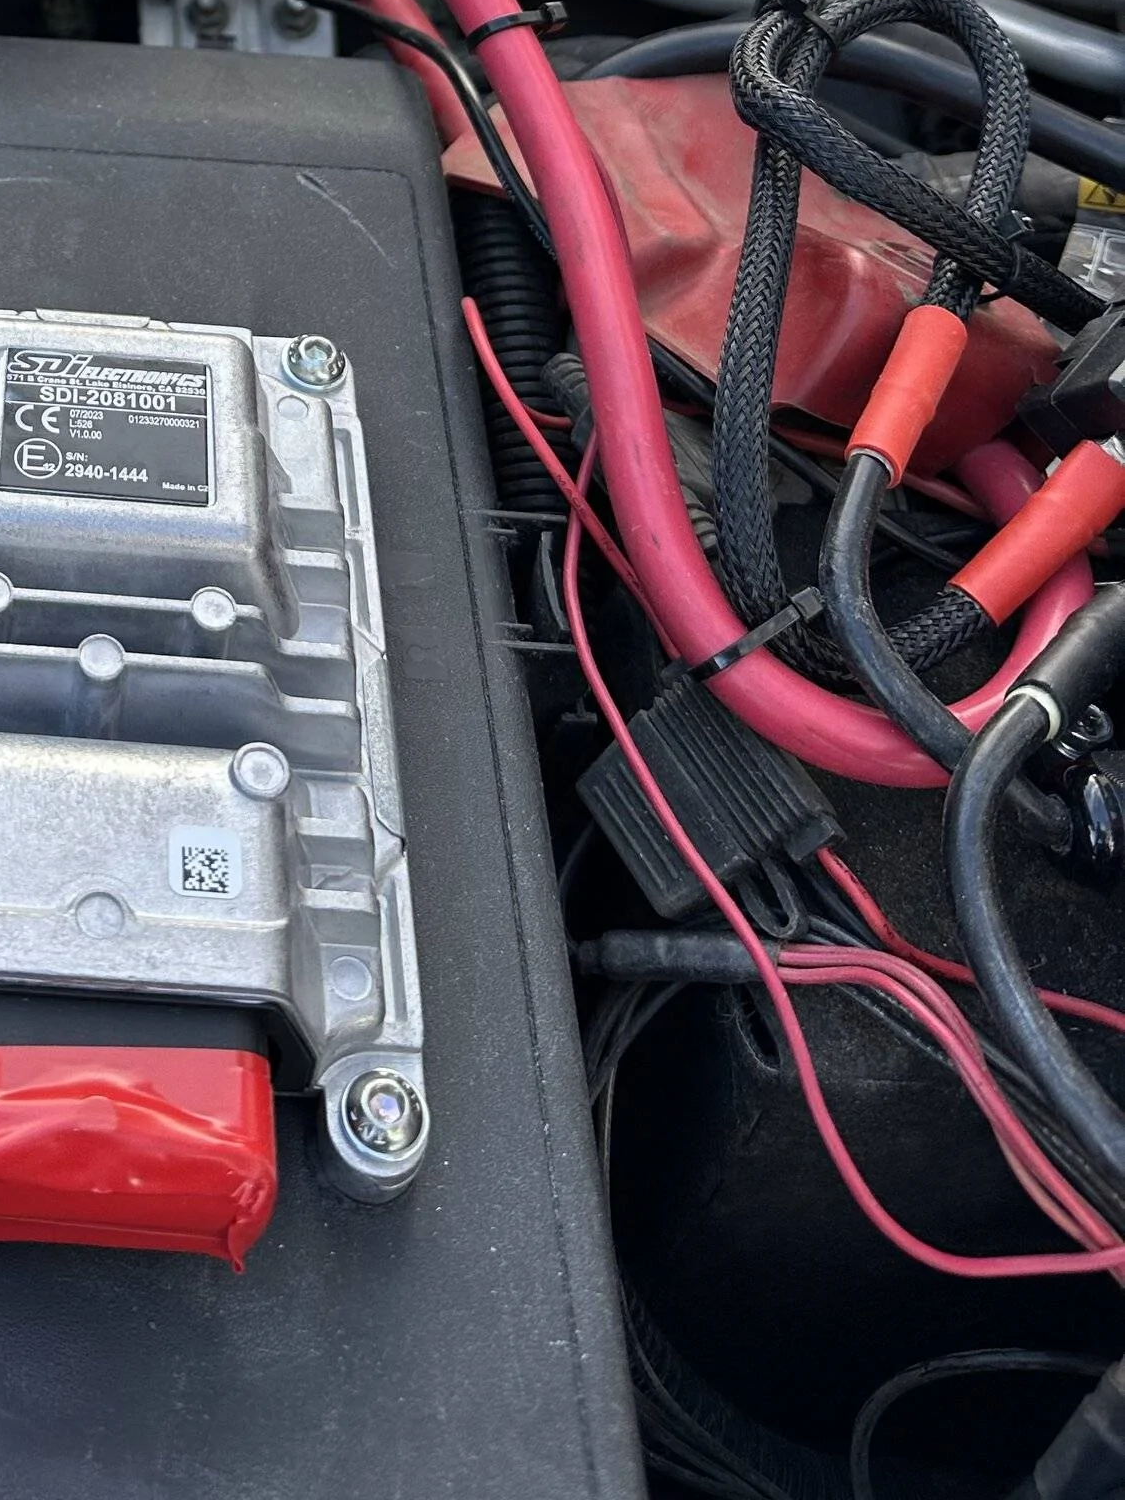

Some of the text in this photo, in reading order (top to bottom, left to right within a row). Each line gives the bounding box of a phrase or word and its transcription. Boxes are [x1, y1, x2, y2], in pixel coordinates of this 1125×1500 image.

[7, 374, 24, 382] 571
[37, 375, 67, 384] Crane
[69, 378, 83, 386] St.
[86, 379, 110, 387] Lake
[176, 387, 206, 395] 92530
[39, 386, 177, 411] SDI-2081001
[69, 409, 200, 429] 07/2023 01233270000321
[69, 429, 103, 440] V1.0.00
[65, 451, 89, 462] S/N:
[64, 463, 149, 483] 2940-1444
[162, 482, 186, 491] Made
